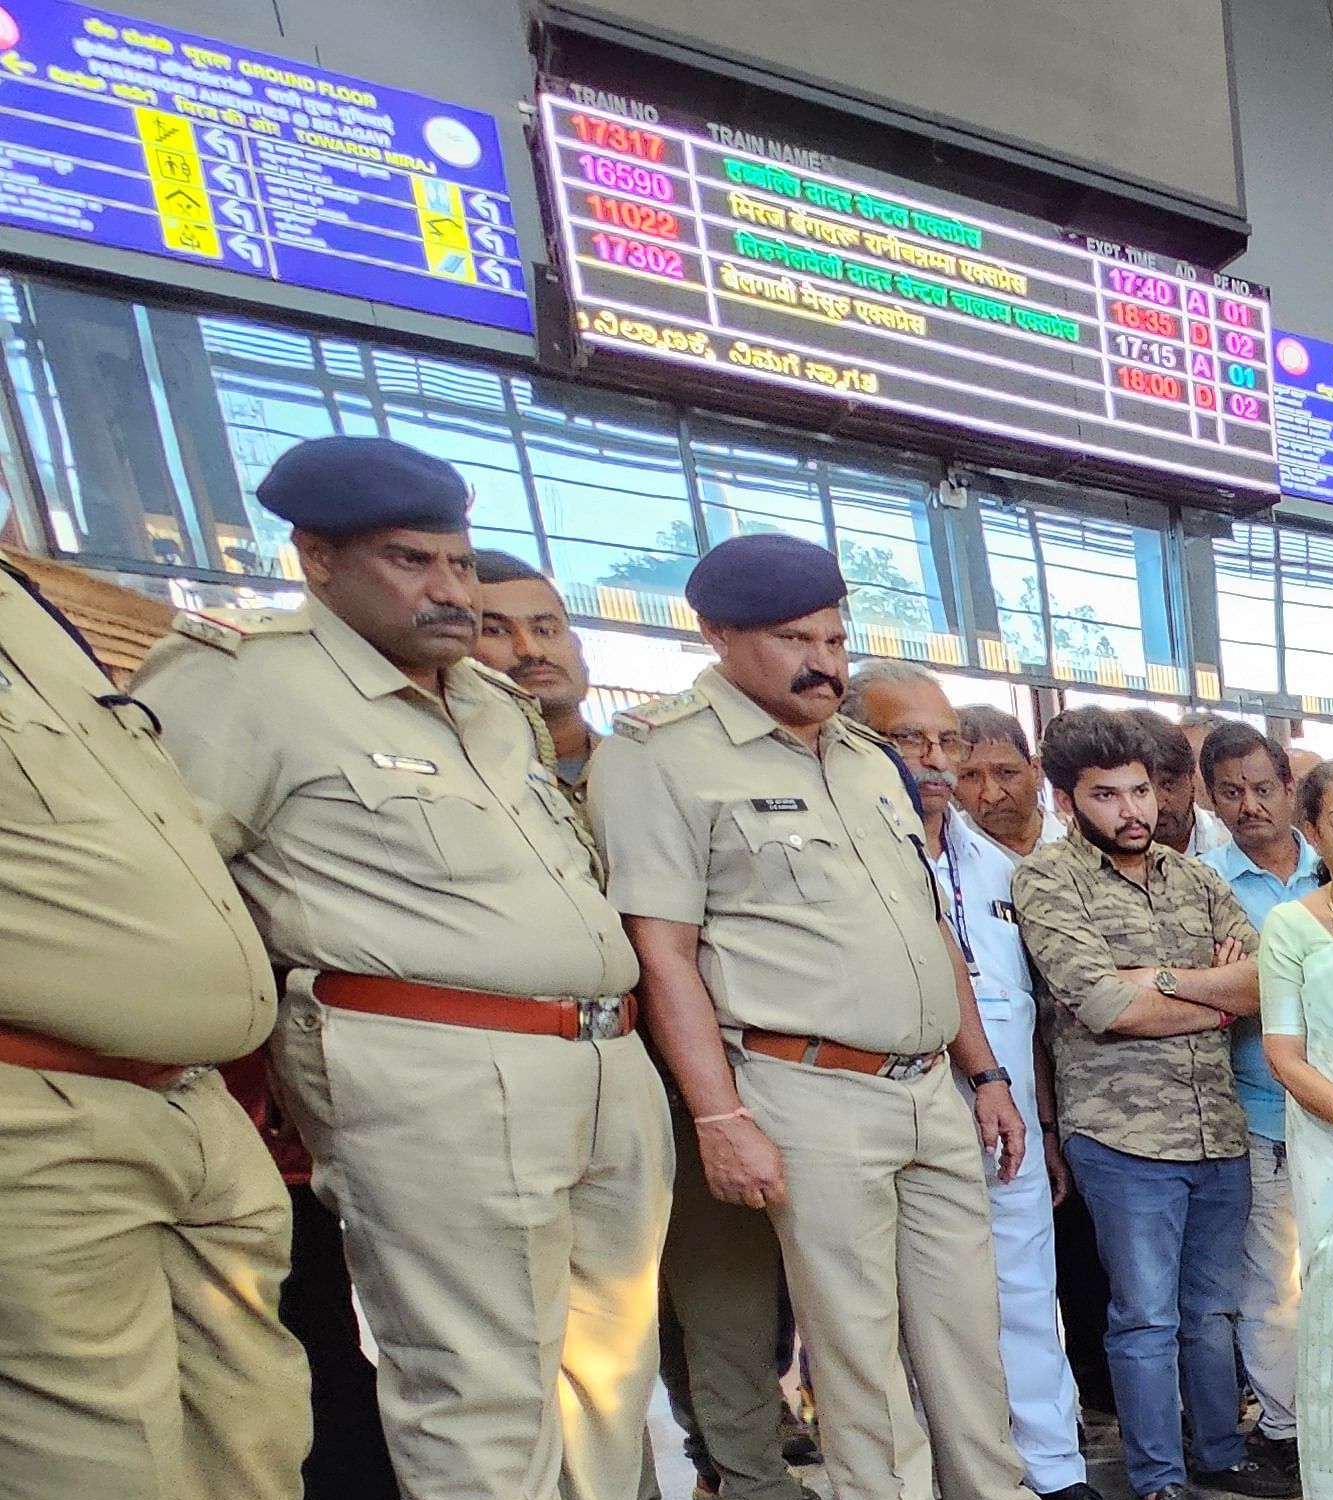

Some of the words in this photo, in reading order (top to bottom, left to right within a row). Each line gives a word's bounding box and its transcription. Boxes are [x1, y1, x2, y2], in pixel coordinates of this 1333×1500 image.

[570, 82, 627, 117] TRAIN
[570, 112, 665, 163] 17317
[706, 122, 765, 157] TRAIN
[578, 154, 673, 202] 16590
[587, 193, 679, 241] 11022
[591, 232, 685, 280] 17302
[1175, 260, 1197, 281] A/D
[1109, 268, 1173, 305] 17:40
[1187, 289, 1206, 315] A
[1112, 301, 1175, 338] 18:35
[1223, 299, 1249, 326] 01
[1116, 334, 1176, 368] 17:15
[1190, 321, 1210, 347] D
[1225, 331, 1254, 359] 02
[1117, 365, 1180, 401] 18:00
[1193, 353, 1213, 379] A
[1227, 363, 1255, 389] 01
[1196, 384, 1216, 410] D
[1230, 393, 1259, 420] 02
